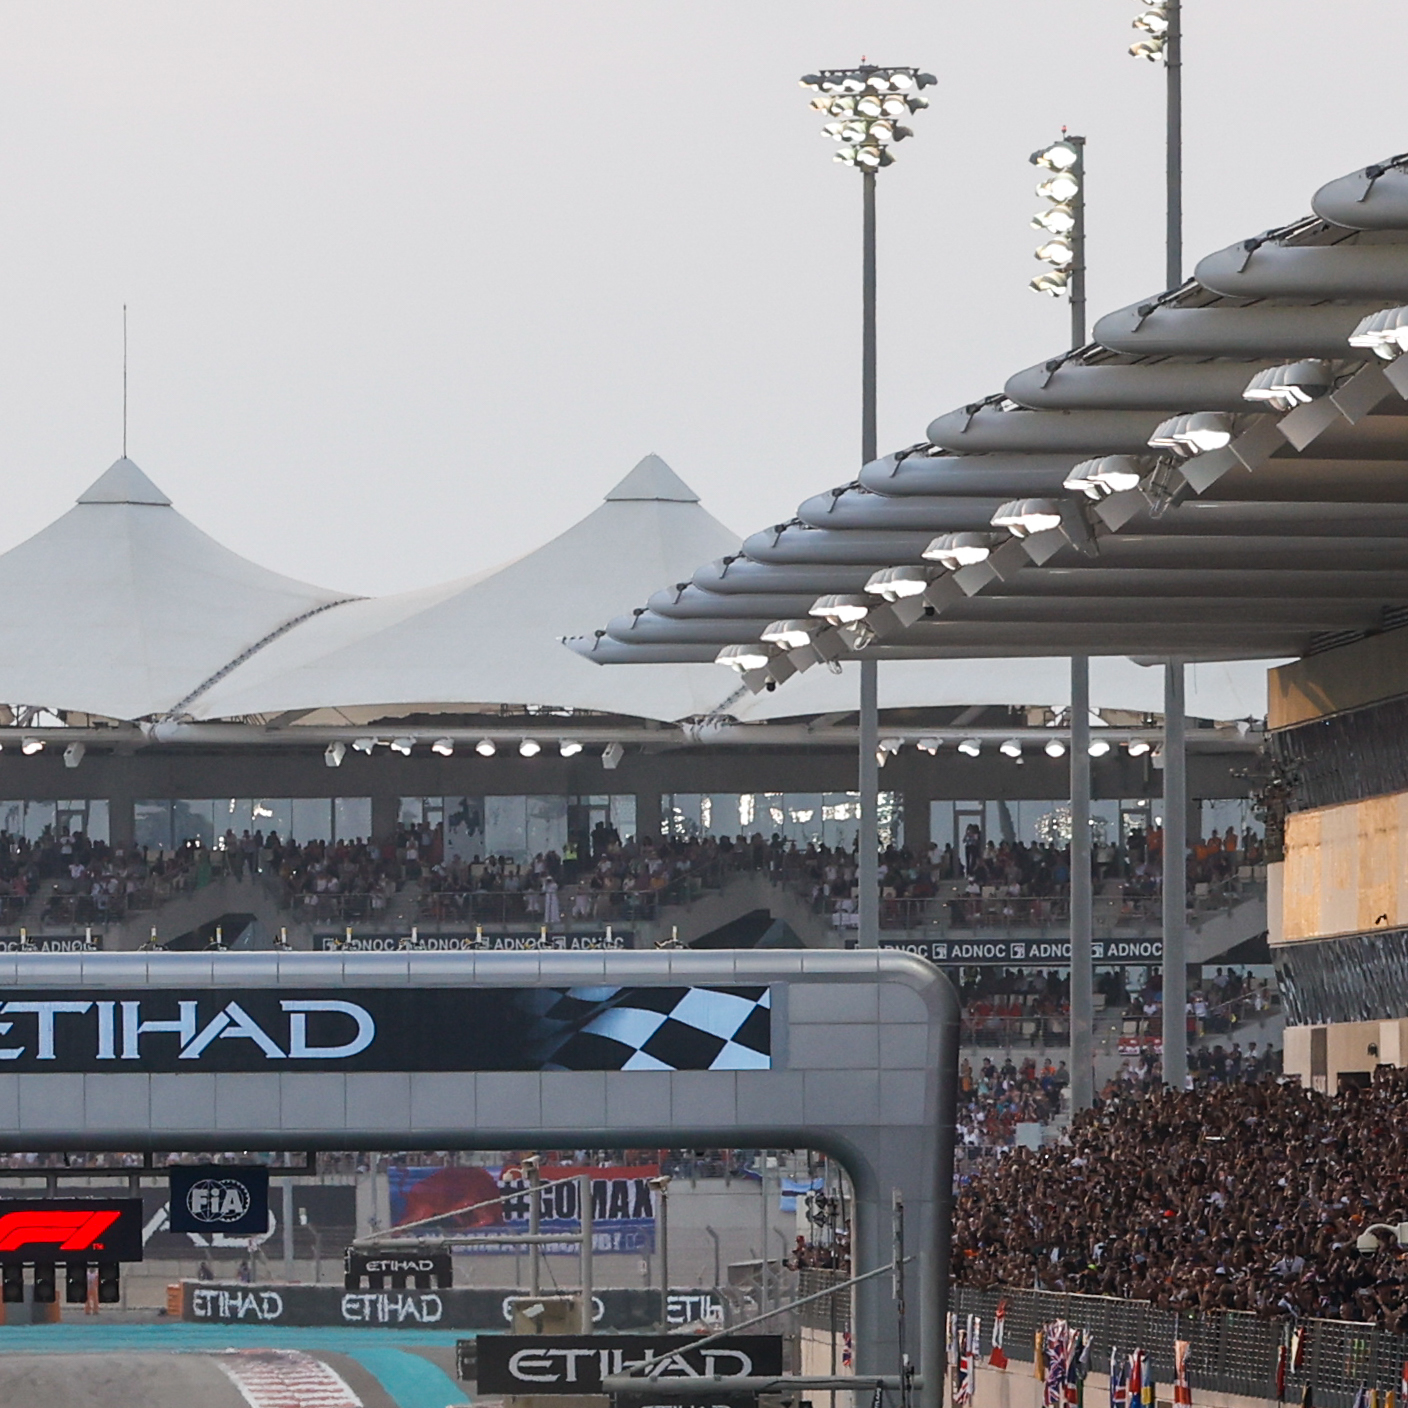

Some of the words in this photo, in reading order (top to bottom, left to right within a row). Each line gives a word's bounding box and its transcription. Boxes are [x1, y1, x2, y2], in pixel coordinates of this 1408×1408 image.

[951, 943, 1006, 958] ADNOC
[1028, 943, 1072, 958] ADNO
[1107, 942, 1163, 957] ADNOC
[365, 1258, 434, 1273] ETIHAD
[191, 1289, 284, 1321] ETIHAD
[340, 1292, 443, 1323] ETIHAD
[508, 1348, 753, 1384] ETIHAD
